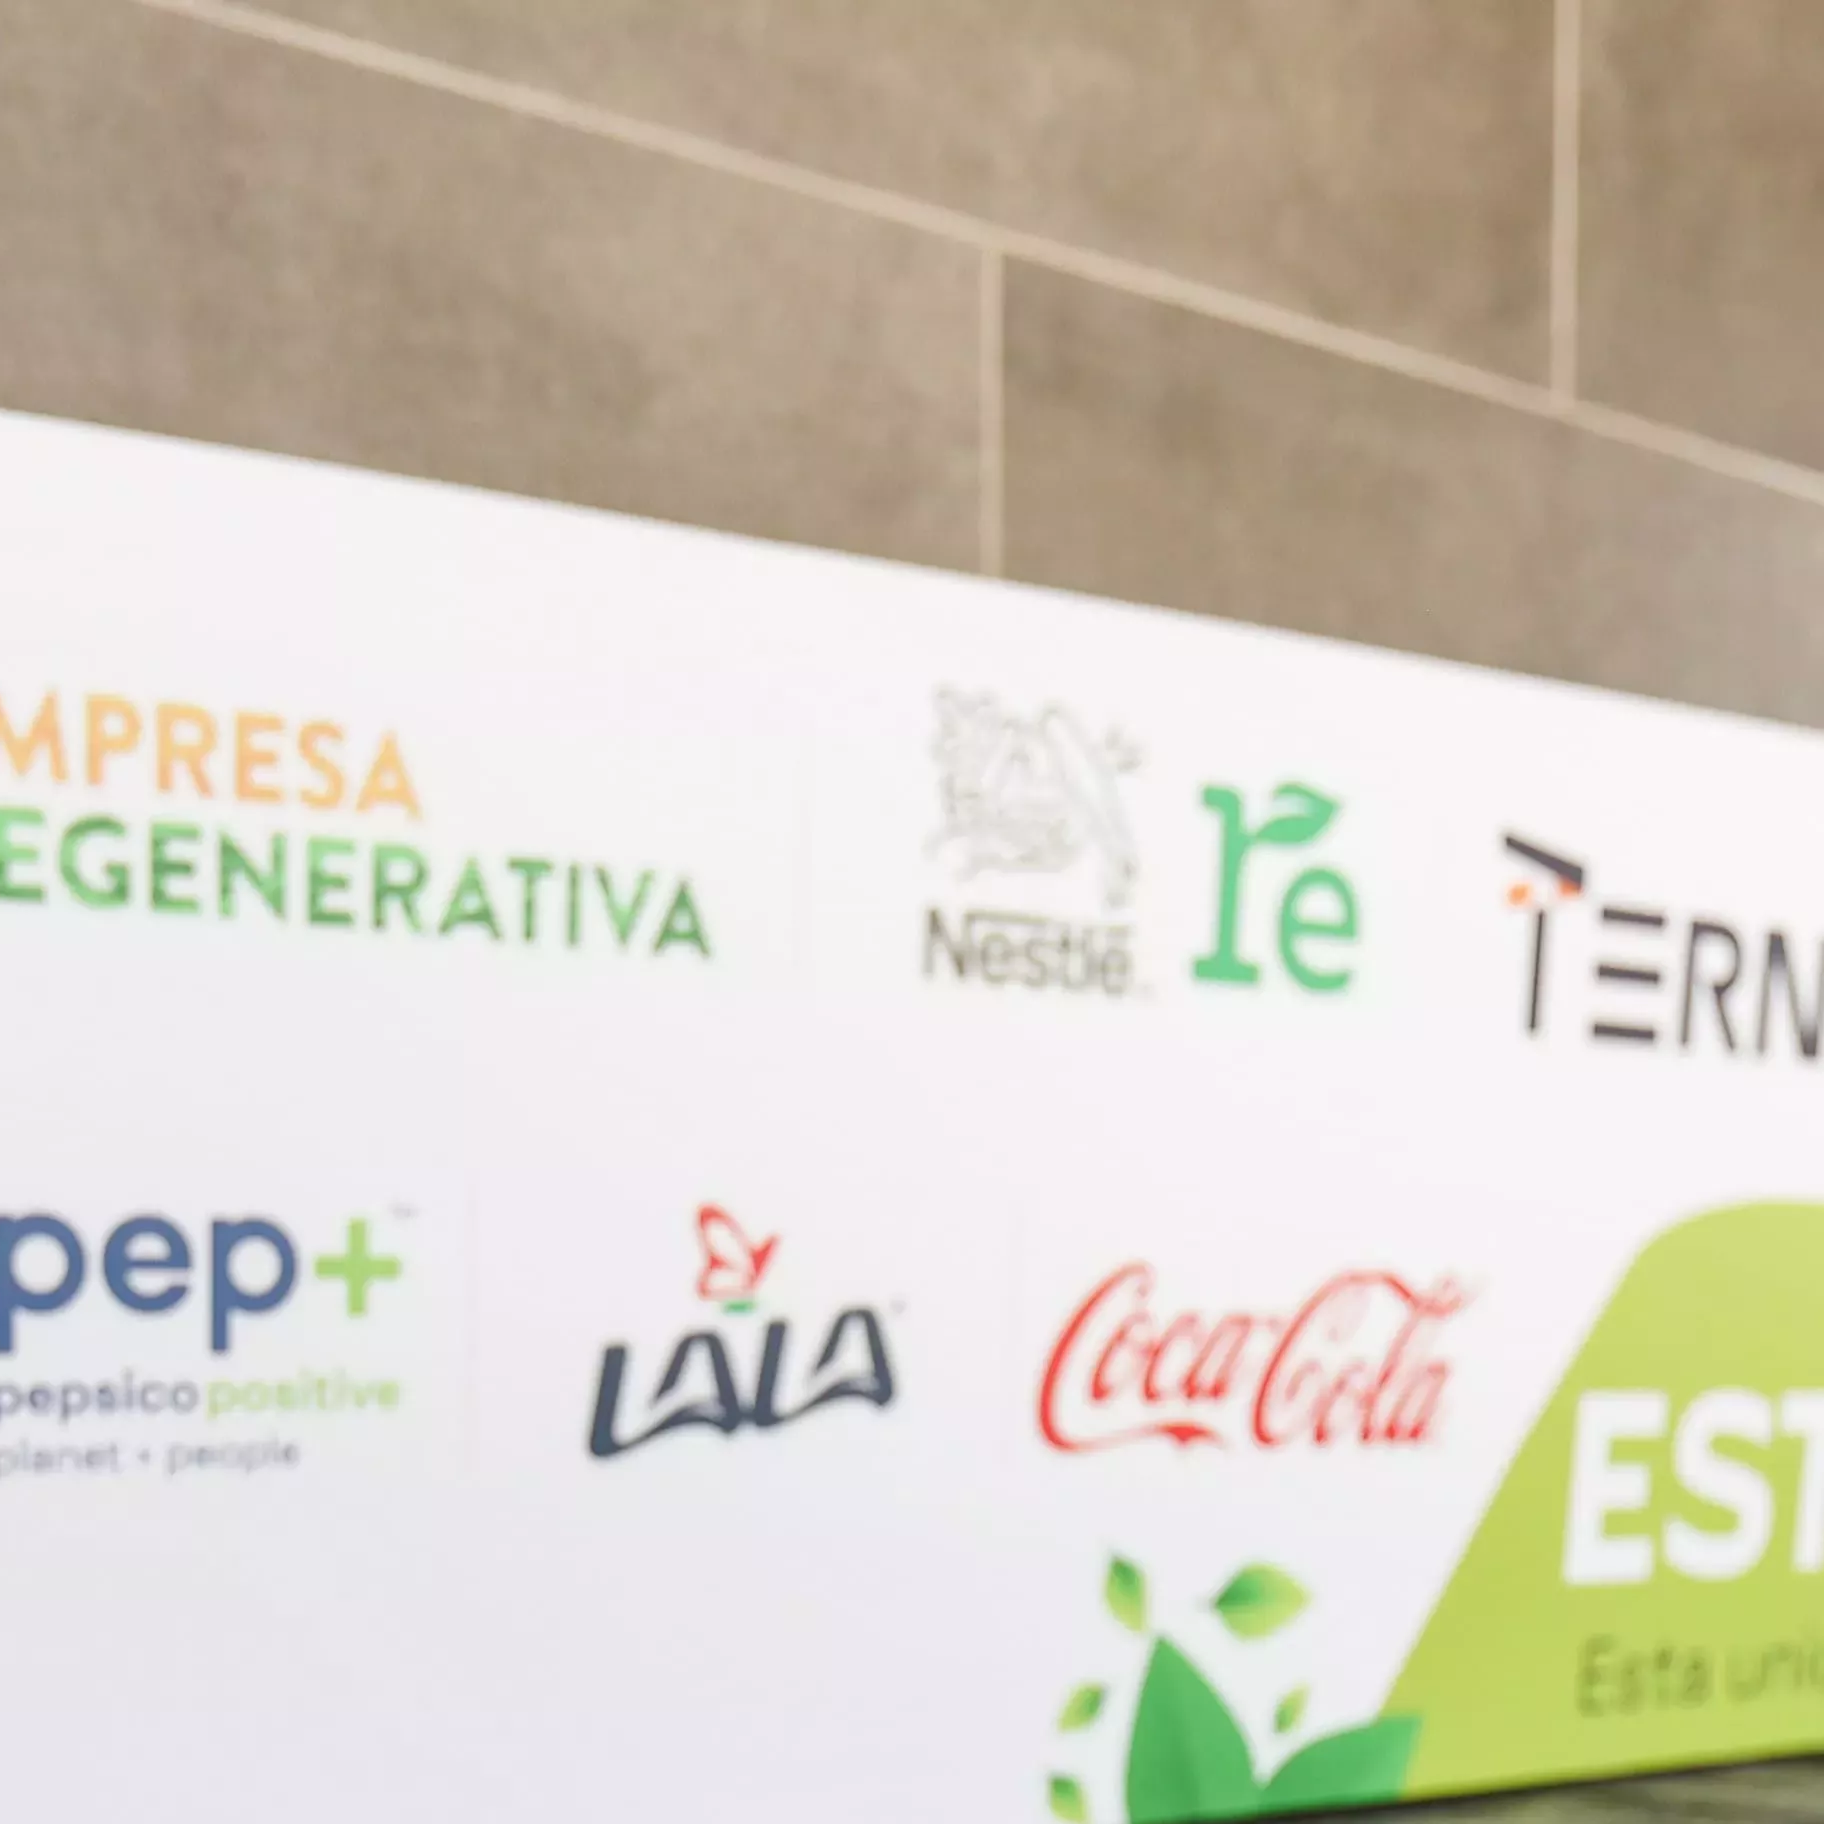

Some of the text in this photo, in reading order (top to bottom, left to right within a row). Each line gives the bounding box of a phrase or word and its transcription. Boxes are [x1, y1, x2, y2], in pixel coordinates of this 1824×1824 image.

[206, 1366, 402, 1422] positive
[589, 1306, 897, 1459] LALA
[166, 1435, 302, 1475] people
[1576, 1633, 1713, 1718] Esta
